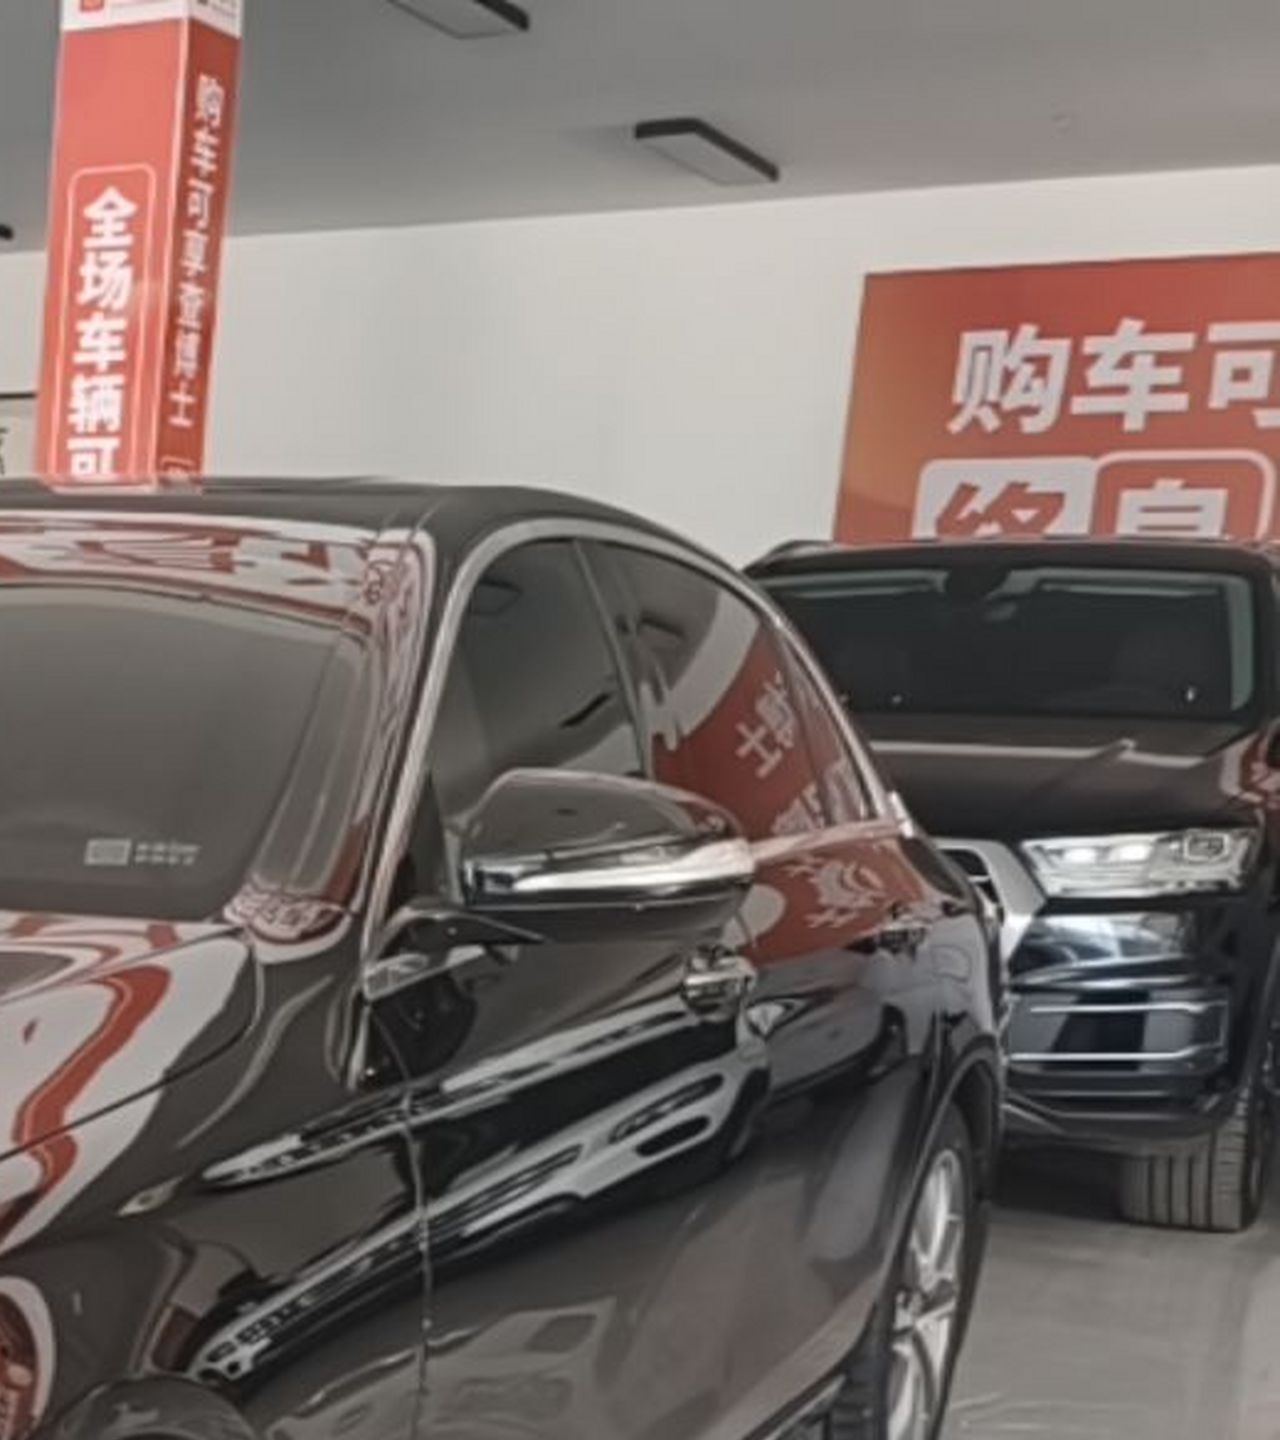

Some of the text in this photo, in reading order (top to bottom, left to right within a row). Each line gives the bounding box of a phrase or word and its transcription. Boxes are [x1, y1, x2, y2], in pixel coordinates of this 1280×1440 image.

[66, 186, 137, 482] 全场车辆可
[947, 318, 1280, 434] 购车可
